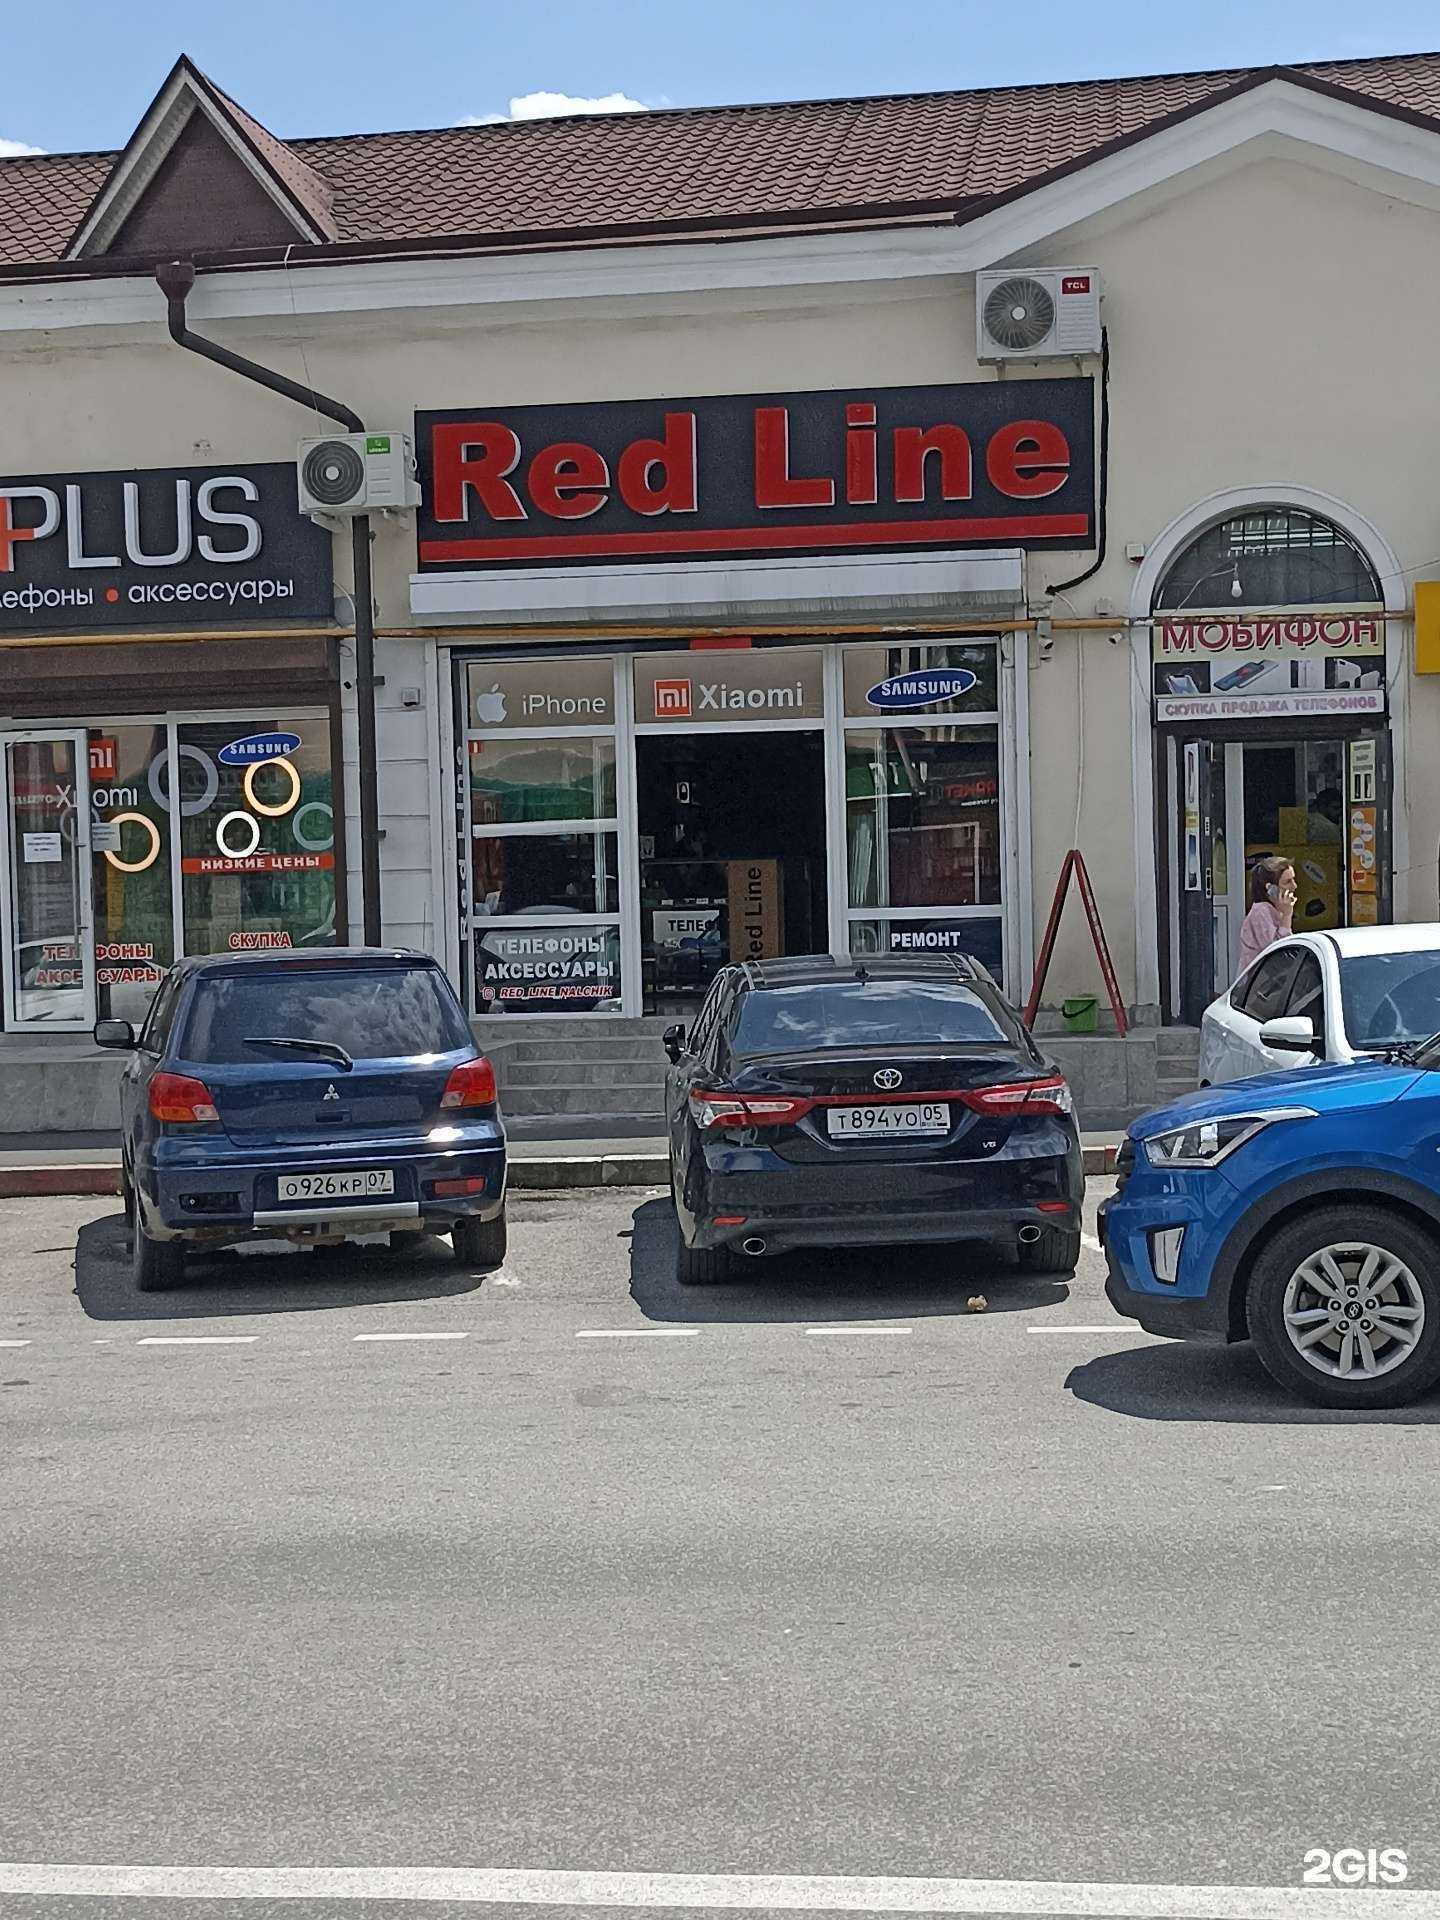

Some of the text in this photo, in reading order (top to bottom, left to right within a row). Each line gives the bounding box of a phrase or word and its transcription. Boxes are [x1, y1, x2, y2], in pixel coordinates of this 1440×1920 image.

[432, 402, 1071, 523] Red Line
[0, 578, 294, 613] ефоны аксессуары
[1162, 615, 1377, 651] МОБИФОН
[698, 682, 803, 710] Xiaomi
[881, 679, 962, 697] SAMSUNG
[522, 693, 606, 716] iPhone
[229, 743, 291, 755] SAMSUNG
[200, 856, 319, 870] НИЗКИЕ ЦЕНЫ
[744, 866, 763, 916] Line
[228, 932, 292, 949] СКУПКА
[494, 936, 605, 954] ТЕЛЕФОНЫ
[891, 931, 960, 948] РЕМОНТ
[43, 943, 154, 961] ТЕЛФОНЫ
[35, 967, 164, 985] АКСЕСУАРЫ
[484, 961, 614, 979] АКСЕССУАРЫ
